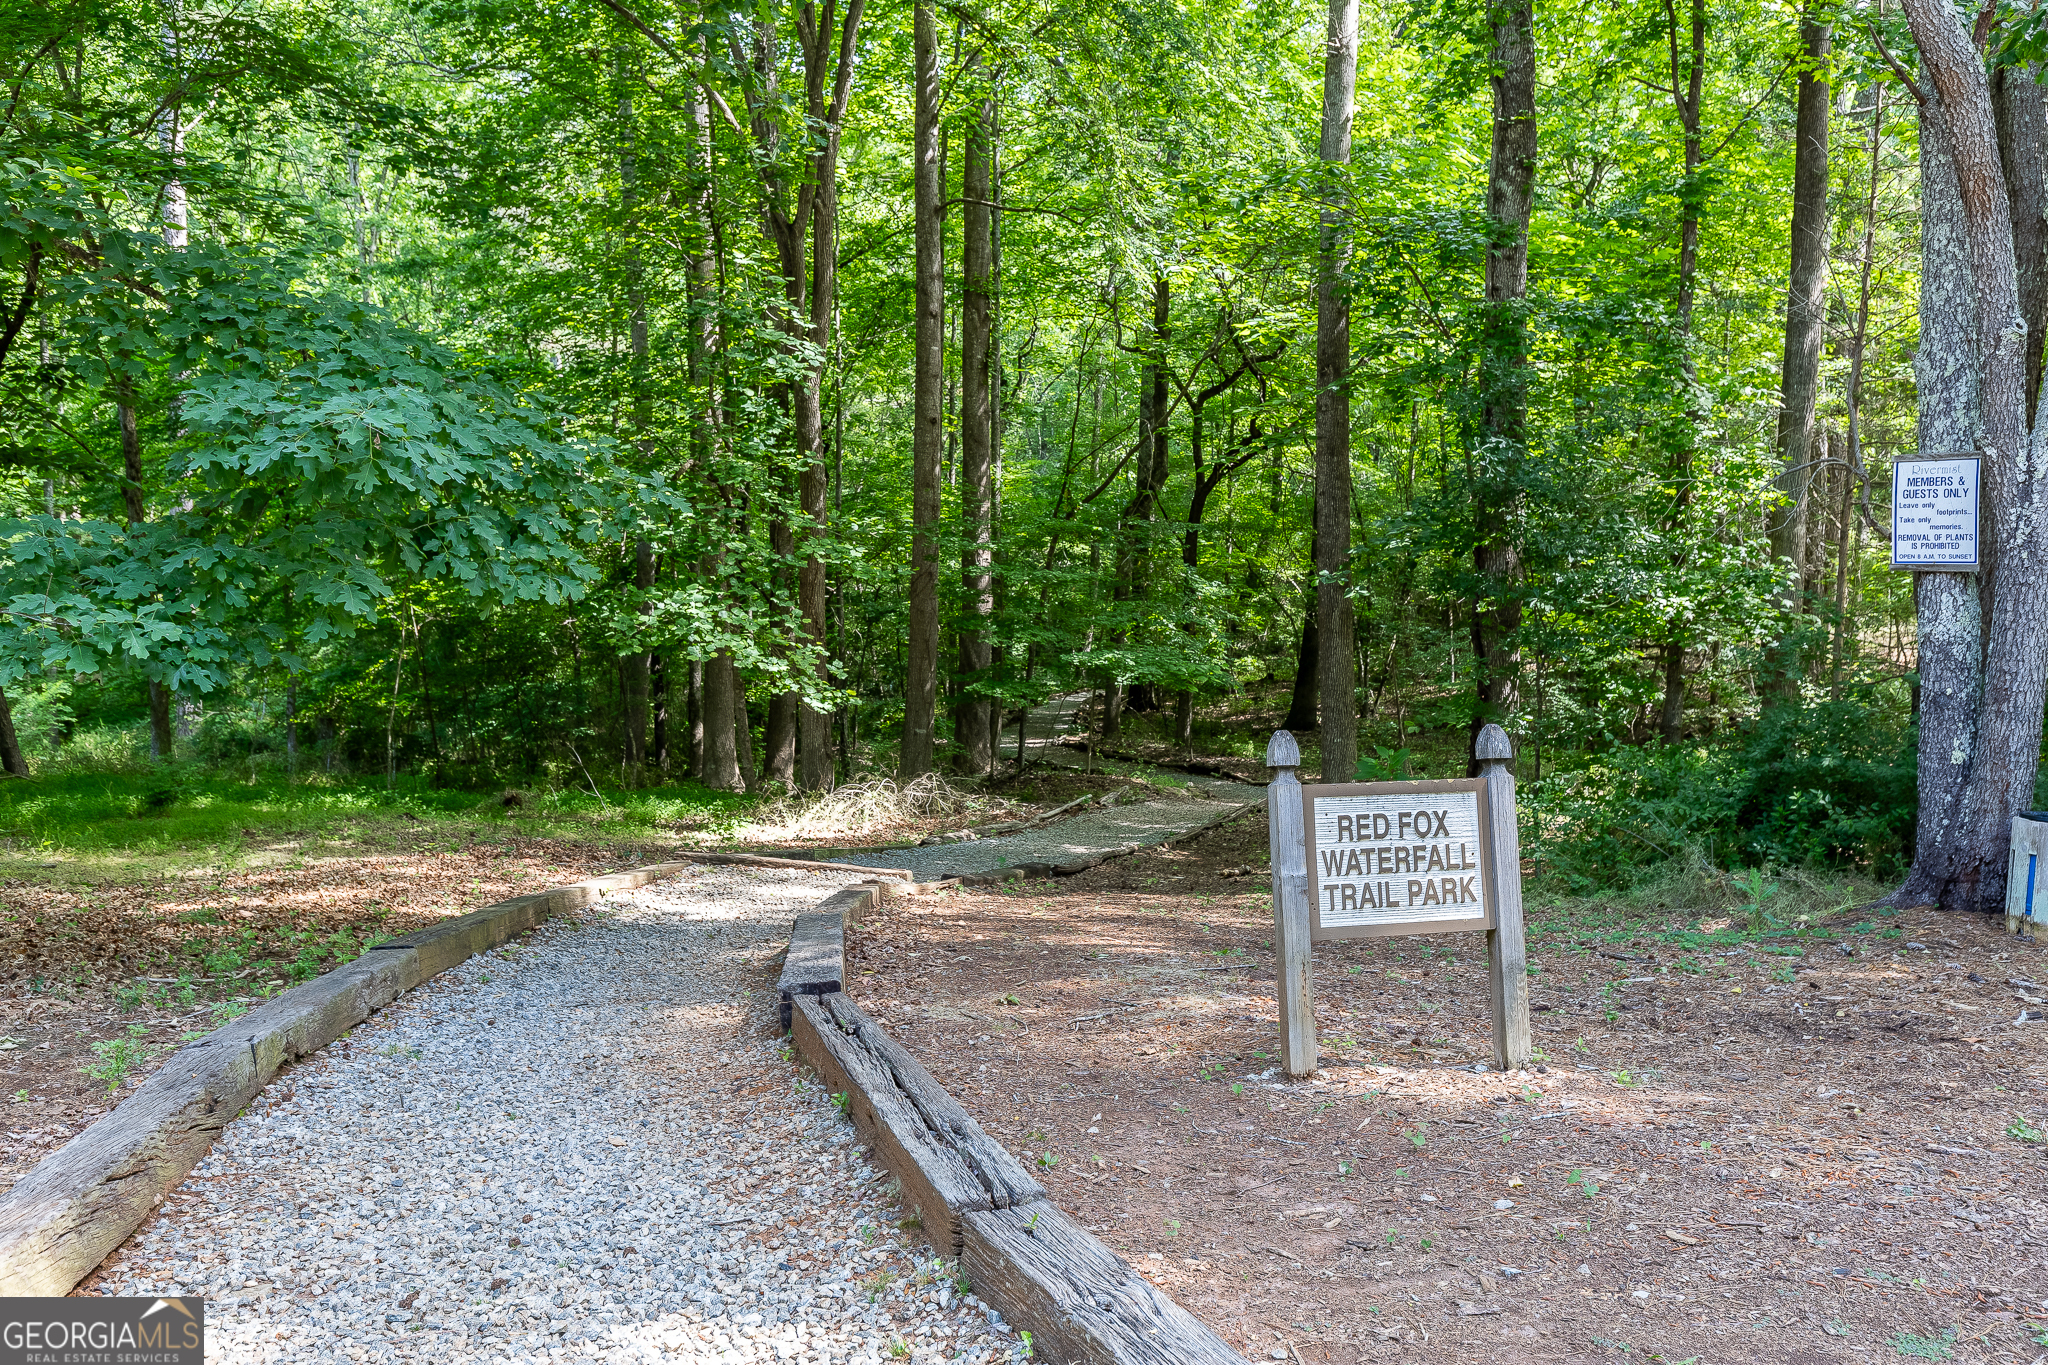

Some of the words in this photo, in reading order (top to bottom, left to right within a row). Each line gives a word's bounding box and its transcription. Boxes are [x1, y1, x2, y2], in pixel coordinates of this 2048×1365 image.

[1903, 489, 1938, 499] GUESTS
[1944, 488, 1969, 498] ONLY
[1907, 477, 1953, 487] MEMBERS
[1959, 476, 1965, 485] &
[1338, 813, 1390, 842] RED
[1398, 810, 1449, 838] FOX
[1321, 843, 1475, 876] WATERFALL
[1324, 881, 1399, 911] TRAIL
[1408, 876, 1477, 906] PARK
